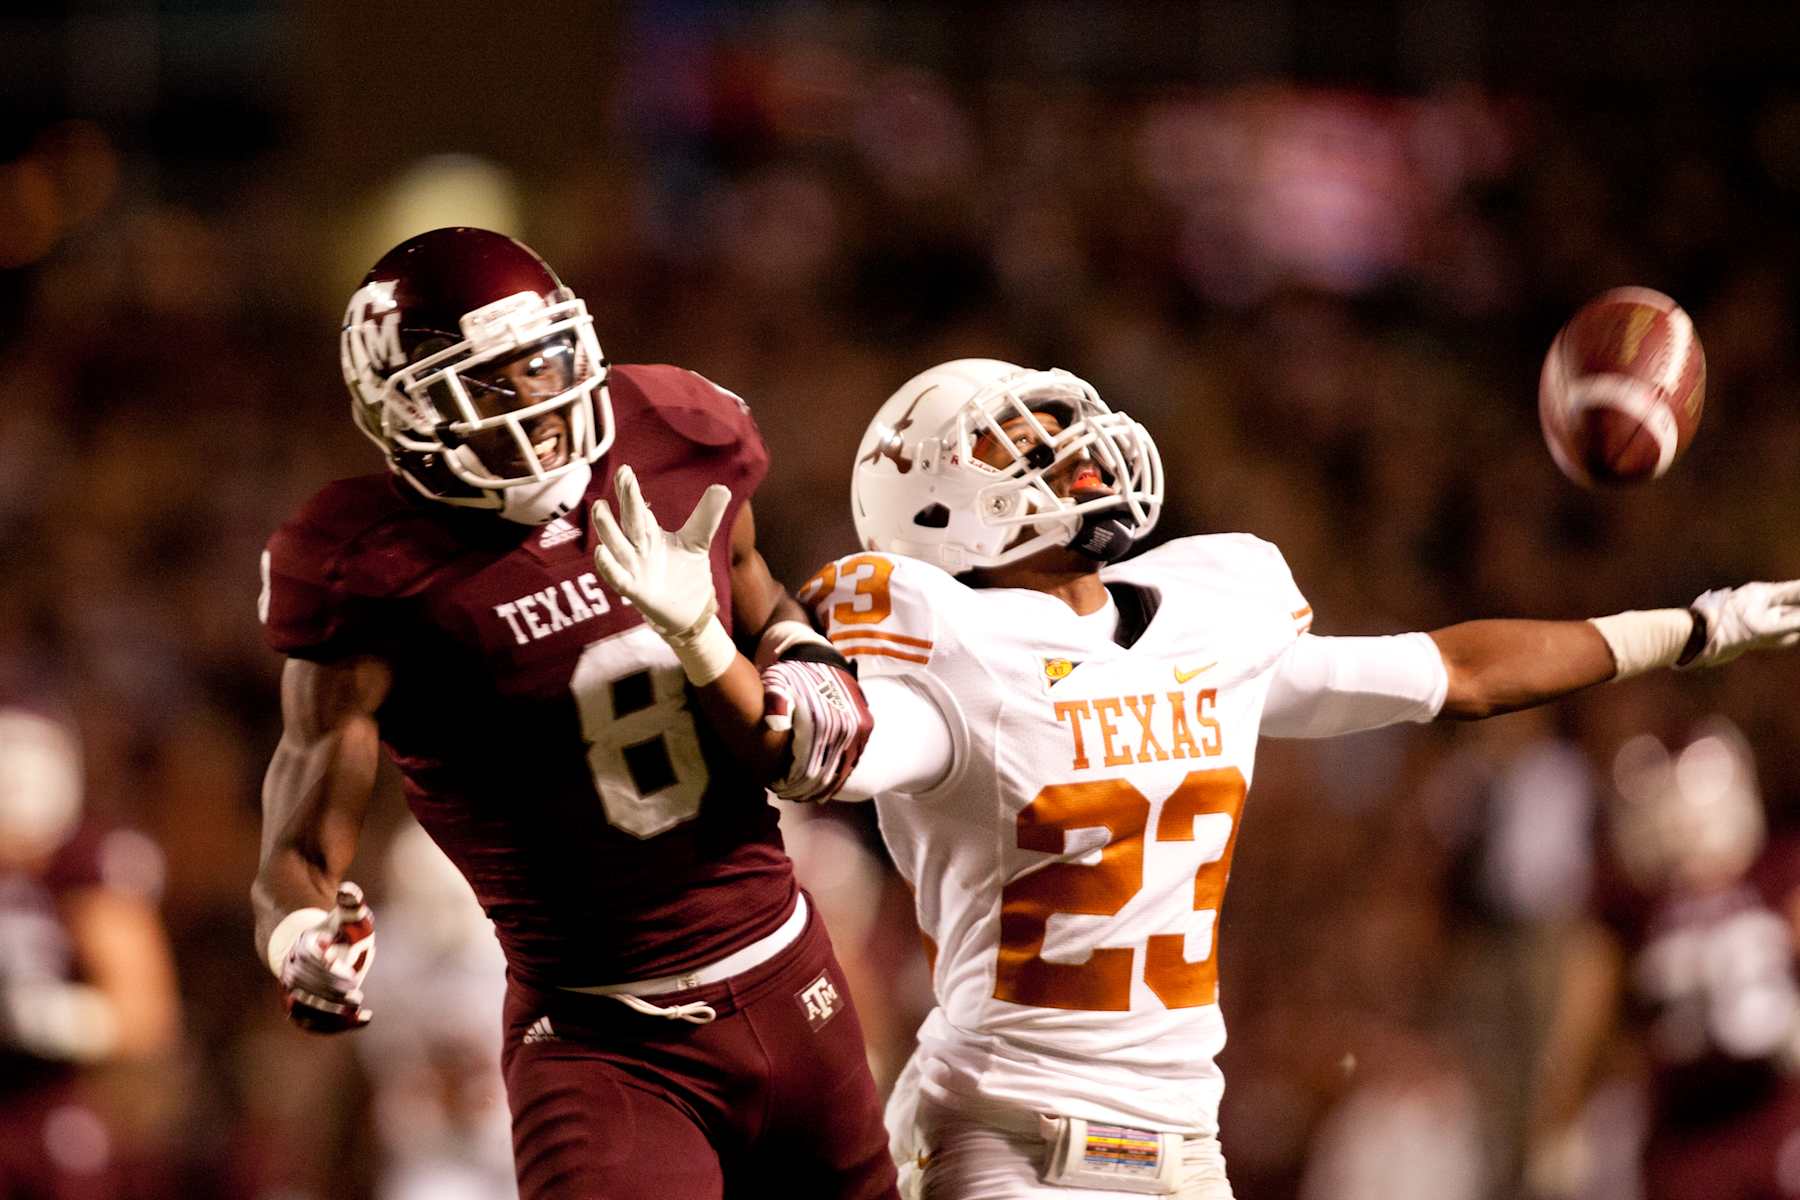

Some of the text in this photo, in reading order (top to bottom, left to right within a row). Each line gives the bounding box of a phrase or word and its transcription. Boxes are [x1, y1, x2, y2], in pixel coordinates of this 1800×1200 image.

[493, 572, 611, 645] TEXAS
[569, 622, 710, 840] 8
[1054, 688, 1223, 770] TEXAS
[992, 766, 1248, 1011] 23
